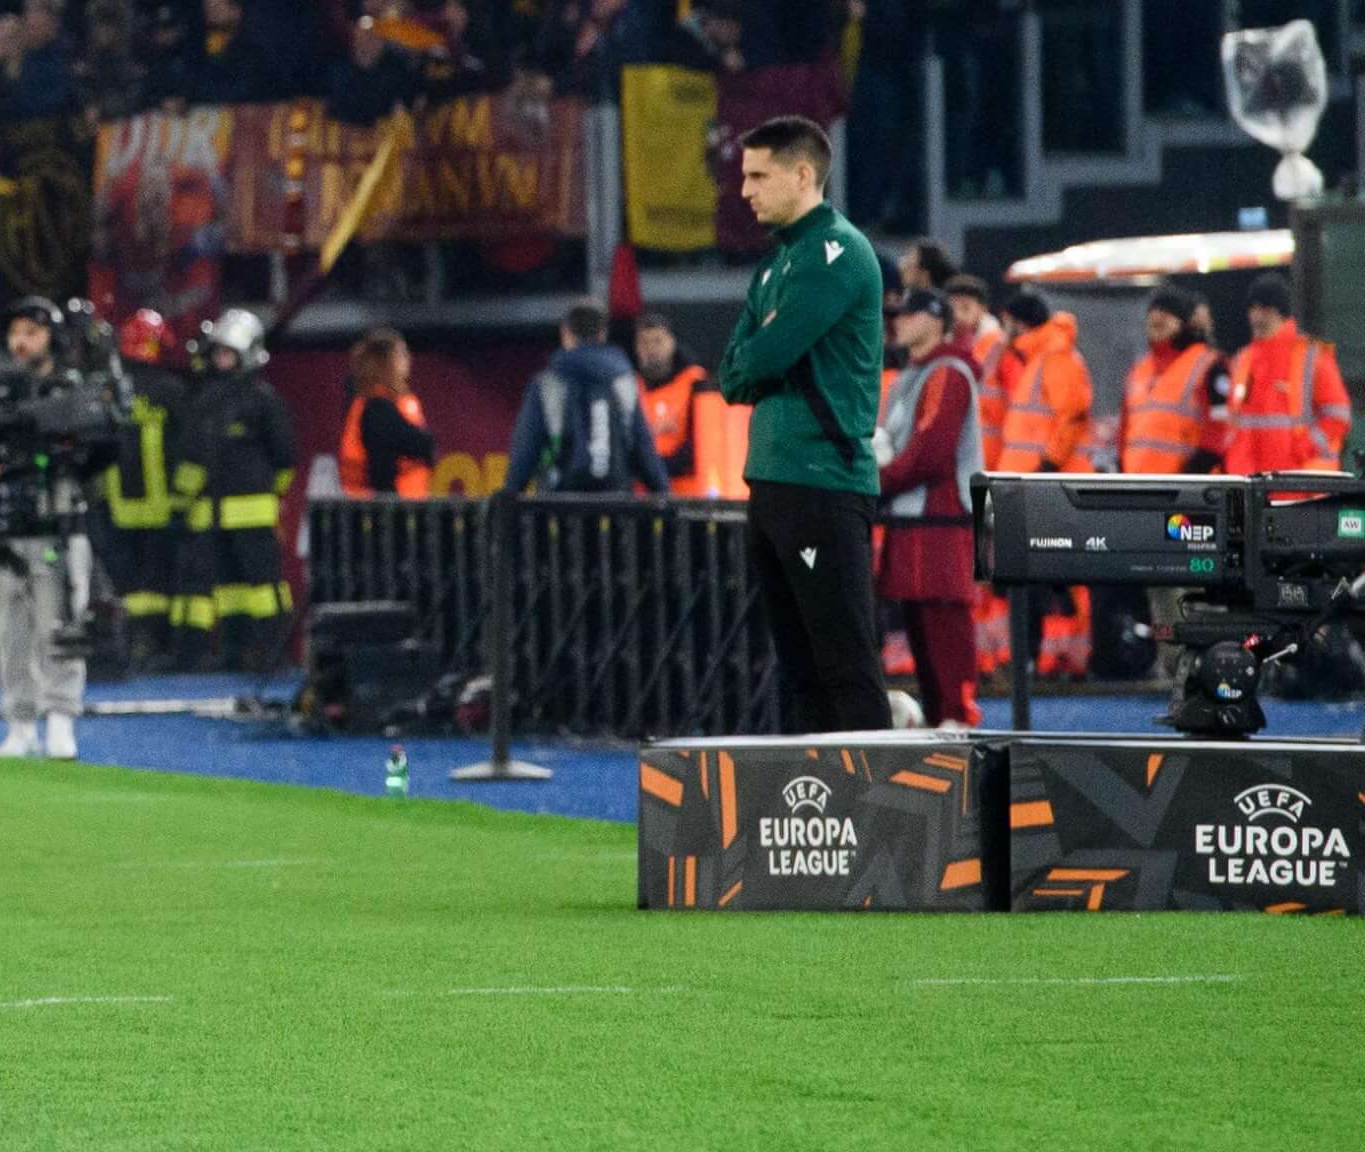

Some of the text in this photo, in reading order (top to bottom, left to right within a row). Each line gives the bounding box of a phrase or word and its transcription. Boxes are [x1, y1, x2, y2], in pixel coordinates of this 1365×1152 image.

[1029, 536, 1107, 551] FUJINON 4K
[1180, 524, 1214, 541] NEP
[784, 782, 828, 808] UEFA
[1237, 790, 1305, 819] UEFA
[759, 817, 858, 847] EUROPA
[1195, 824, 1351, 857] EUROPA
[768, 850, 850, 876] LEAGUE
[1209, 858, 1337, 886] LEAGUE
